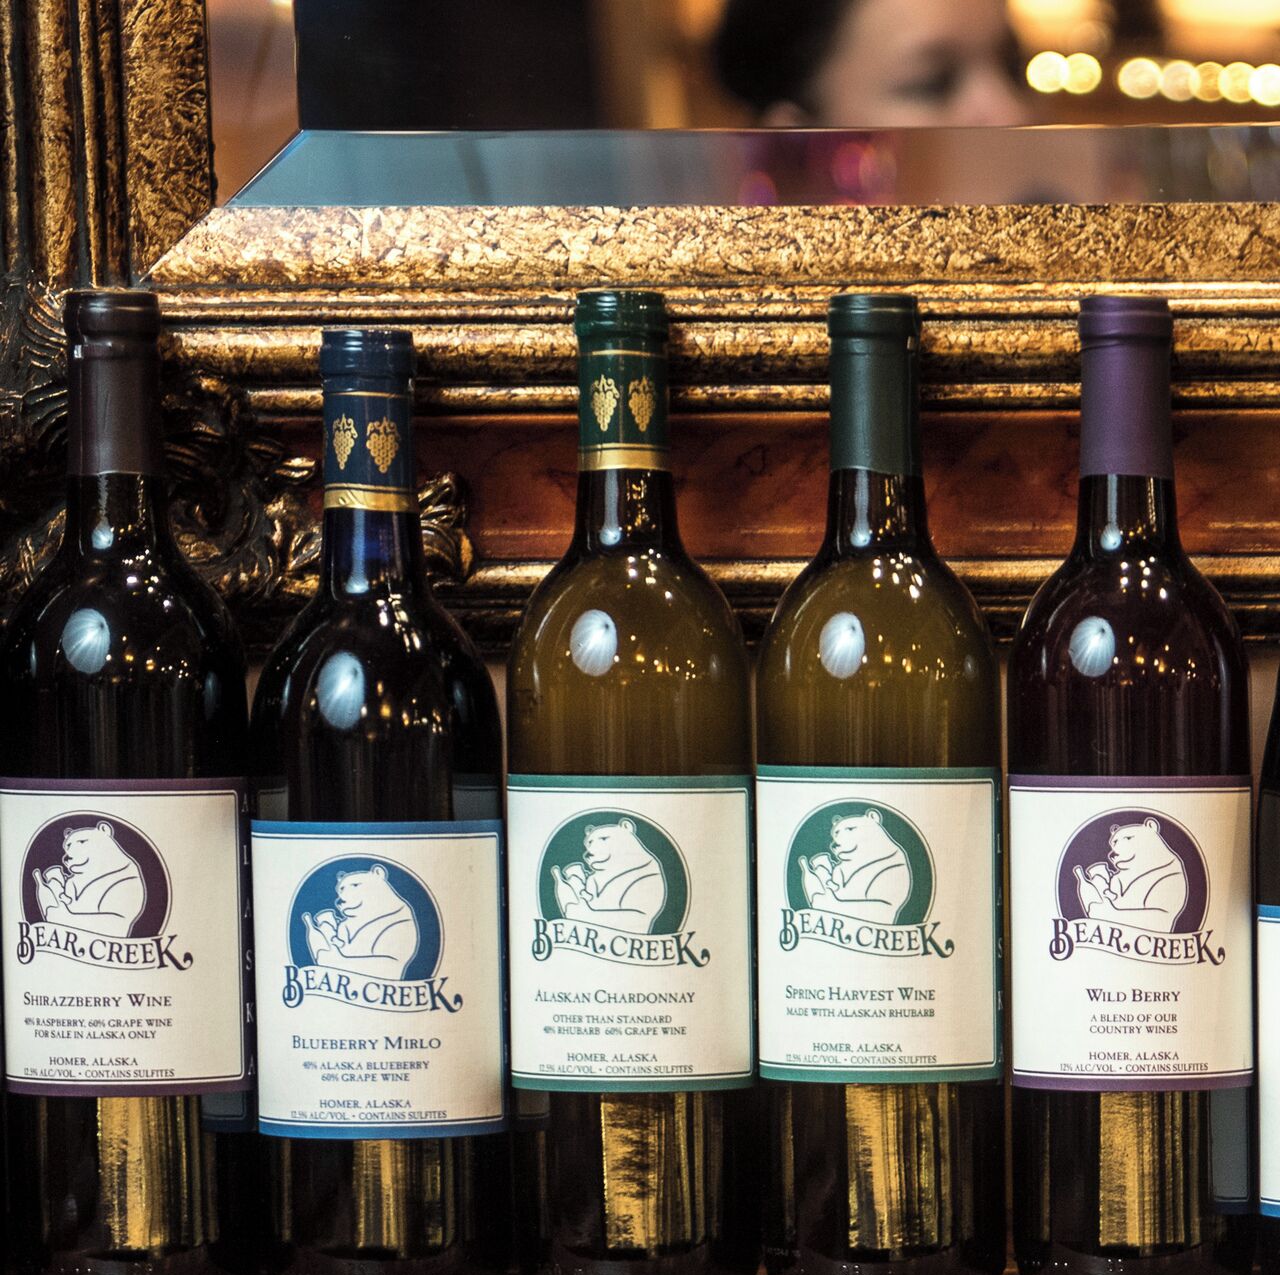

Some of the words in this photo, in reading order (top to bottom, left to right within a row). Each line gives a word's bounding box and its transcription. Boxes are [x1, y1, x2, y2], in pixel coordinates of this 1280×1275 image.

[779, 908, 851, 951] BEAR
[855, 921, 955, 958] CREEK
[17, 922, 86, 965] BEAR
[89, 934, 193, 971] CREEK
[532, 919, 606, 961] BEAR
[610, 931, 710, 967] CREEK
[1050, 918, 1130, 961] BEAR
[1134, 930, 1226, 966] CREEK
[283, 965, 358, 1008] BEAR
[362, 976, 463, 1013] CREEK
[785, 985, 825, 1000] SPRING
[828, 986, 894, 1001] HARVEST
[898, 987, 936, 1001] WINE
[23, 991, 122, 1008] SHIRAZZBERRY
[127, 993, 173, 1007] WINE
[535, 989, 591, 1003] ALASKAN
[594, 989, 695, 1004] CHARDONNAY
[1086, 988, 1127, 1003] WILD
[1131, 988, 1181, 1003] BERRY
[786, 1007, 809, 1017] MADE
[811, 1008, 835, 1017] WITH
[837, 1008, 885, 1018] ALASKAN
[888, 1009, 935, 1018] RHUBARB
[1090, 1014, 1098, 1023] A
[1100, 1014, 1134, 1023] BLEND
[1136, 1014, 1152, 1023] OF
[1154, 1013, 1177, 1022] OUR
[108, 1018, 142, 1028] GRAPE
[145, 1018, 173, 1027] WINE
[552, 1014, 583, 1024] OTHER
[586, 1015, 615, 1024] THAN
[617, 1015, 672, 1024] STANDARD
[34, 1029, 49, 1038] FOR
[50, 1029, 72, 1039] SALE
[73, 1030, 84, 1039] IN
[85, 1030, 126, 1040] ALASKA
[128, 1030, 157, 1039] ONLY
[1089, 1025, 1143, 1034] COUNTRY
[1145, 1025, 1178, 1034] WINES
[292, 1035, 379, 1050] BLUEBERRY
[384, 1036, 442, 1050] MIRLO
[856, 1043, 903, 1053] ALASKA
[91, 1057, 138, 1066] ALASKA
[611, 1053, 658, 1062] ALASKA
[1135, 1052, 1179, 1061] ALASKA
[365, 1099, 412, 1108] ALASKA
